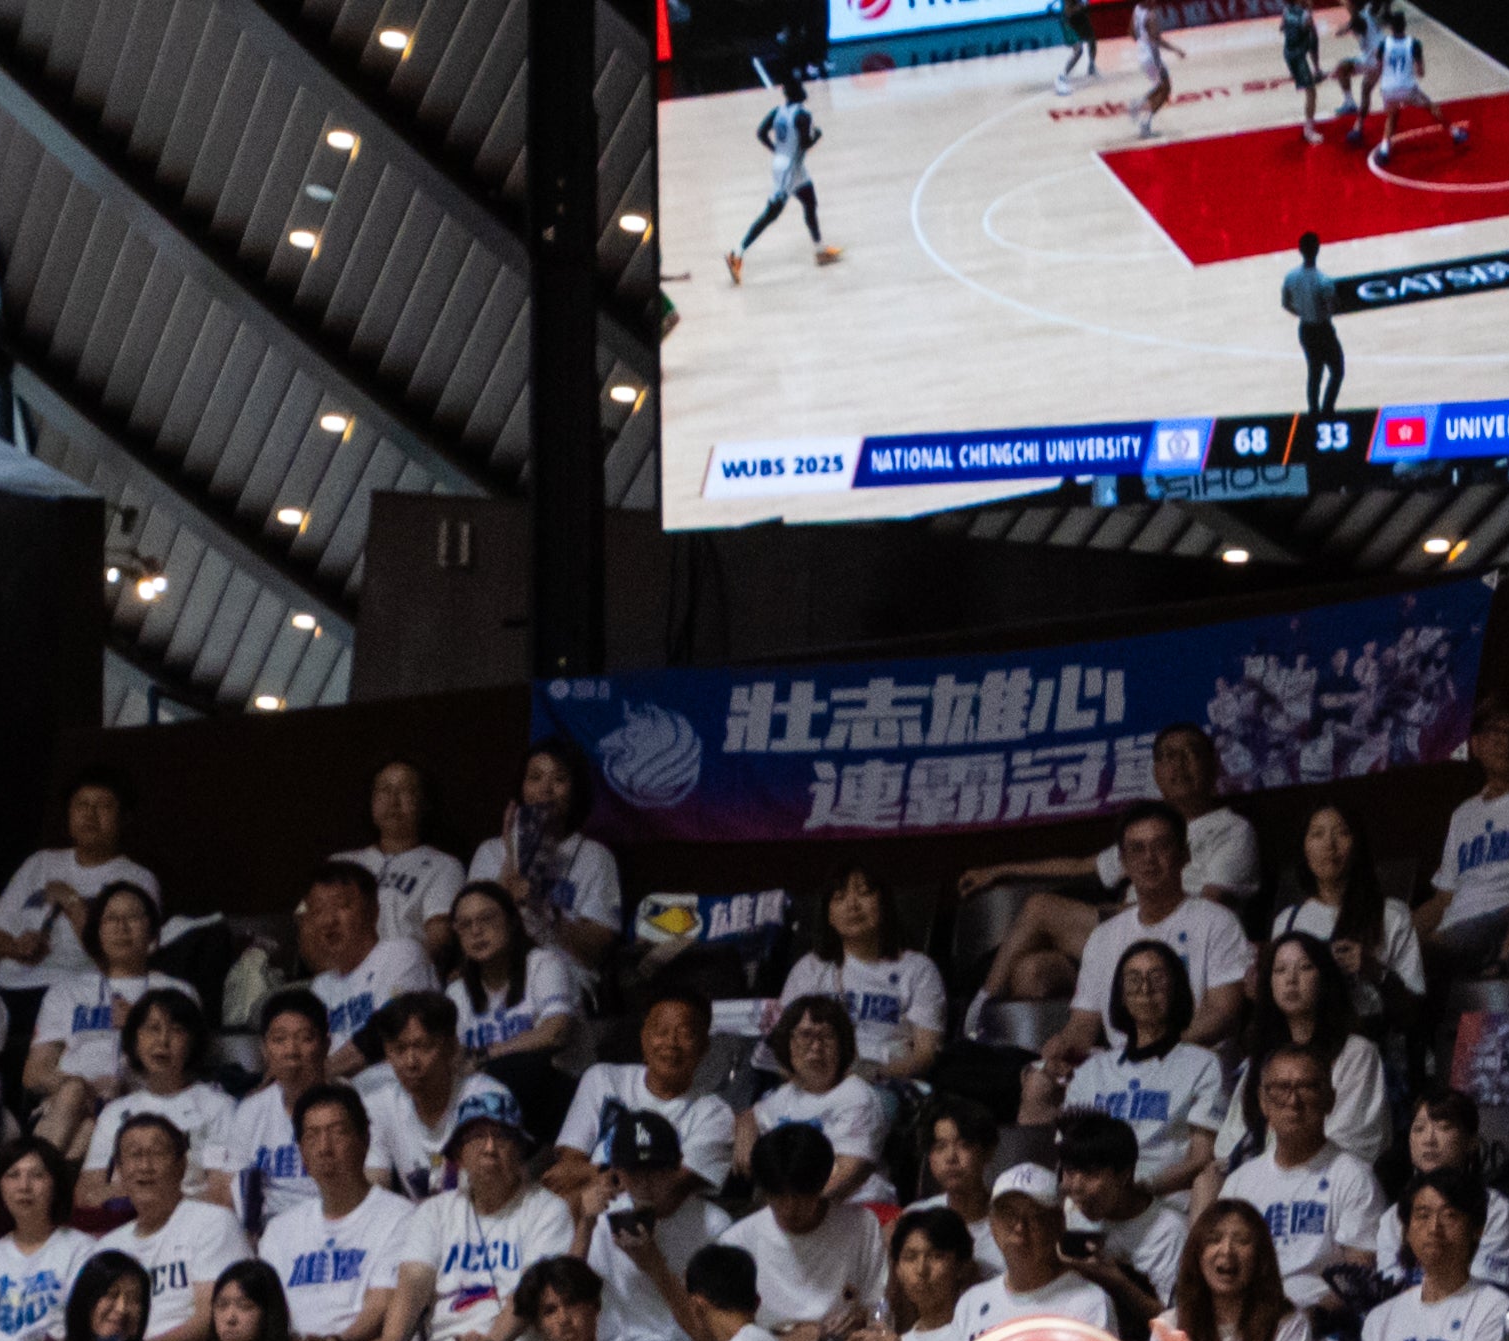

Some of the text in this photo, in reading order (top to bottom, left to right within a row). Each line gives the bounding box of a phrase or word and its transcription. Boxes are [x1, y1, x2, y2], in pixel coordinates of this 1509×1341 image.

[1233, 426, 1269, 454] 68
[1316, 422, 1350, 450] 33
[721, 453, 845, 480] WUBS 2025
[871, 434, 1142, 473] NATIONAL CHENGCHI UNIVERSITY
[722, 664, 1125, 753] 壯志雄心
